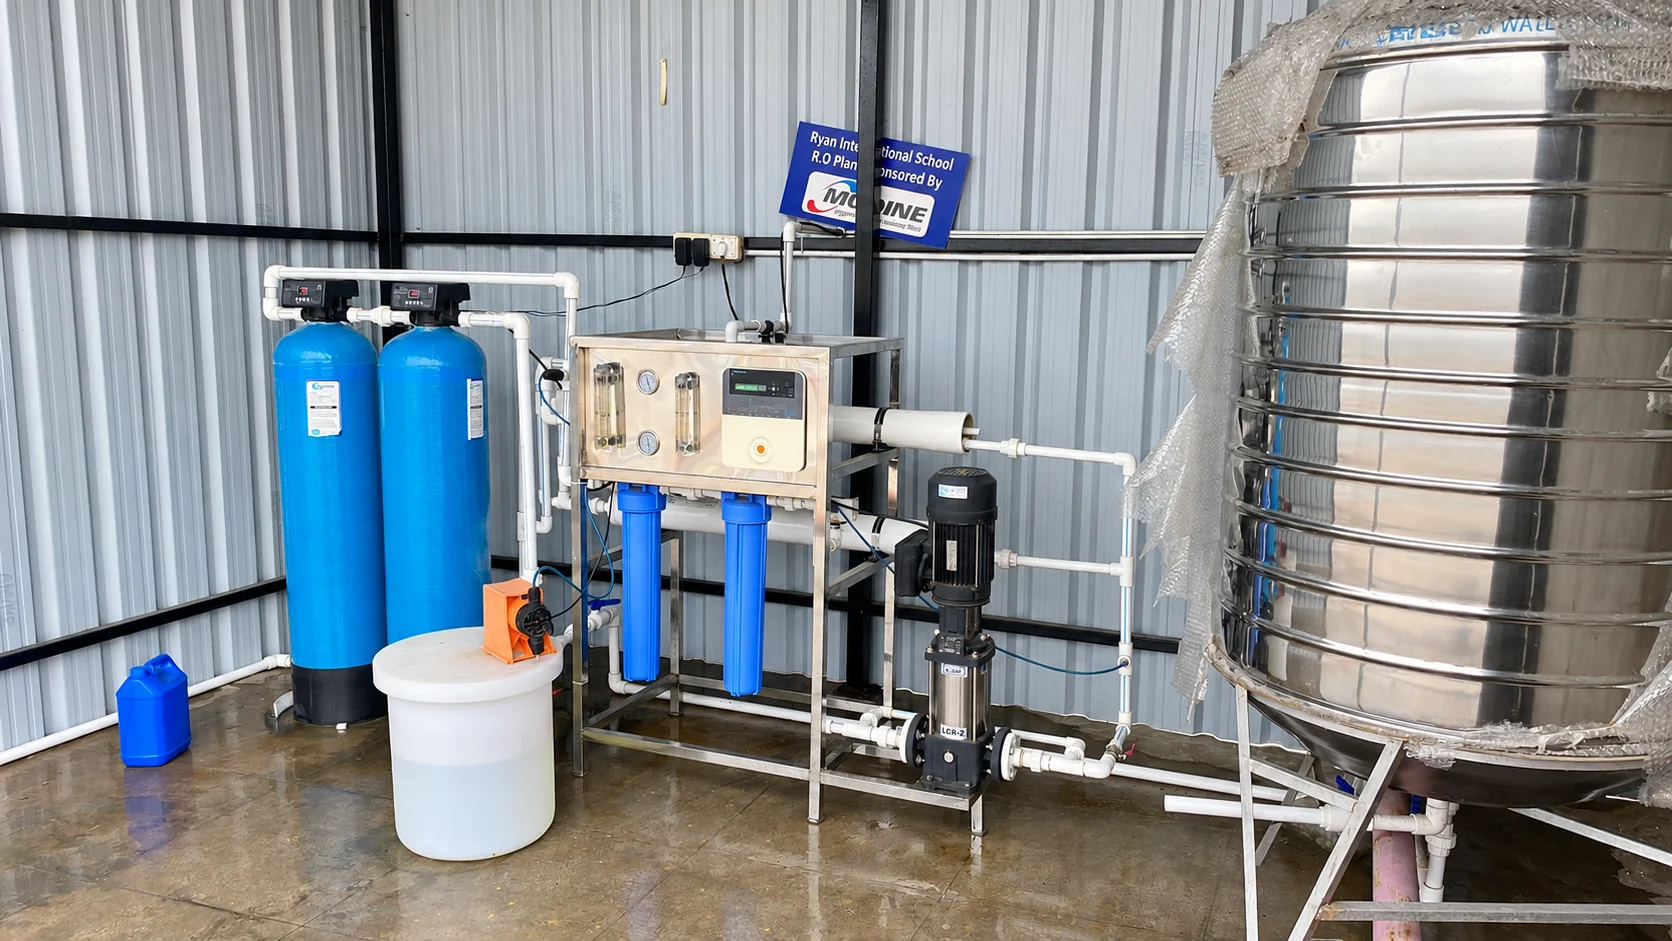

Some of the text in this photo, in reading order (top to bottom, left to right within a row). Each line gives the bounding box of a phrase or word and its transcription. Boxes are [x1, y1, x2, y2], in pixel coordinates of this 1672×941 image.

[810, 131, 955, 171] Ryan Intetional School
[811, 150, 831, 165] R.O
[833, 154, 857, 171] Plan
[927, 174, 943, 191] By
[942, 727, 965, 737] LCR-2
